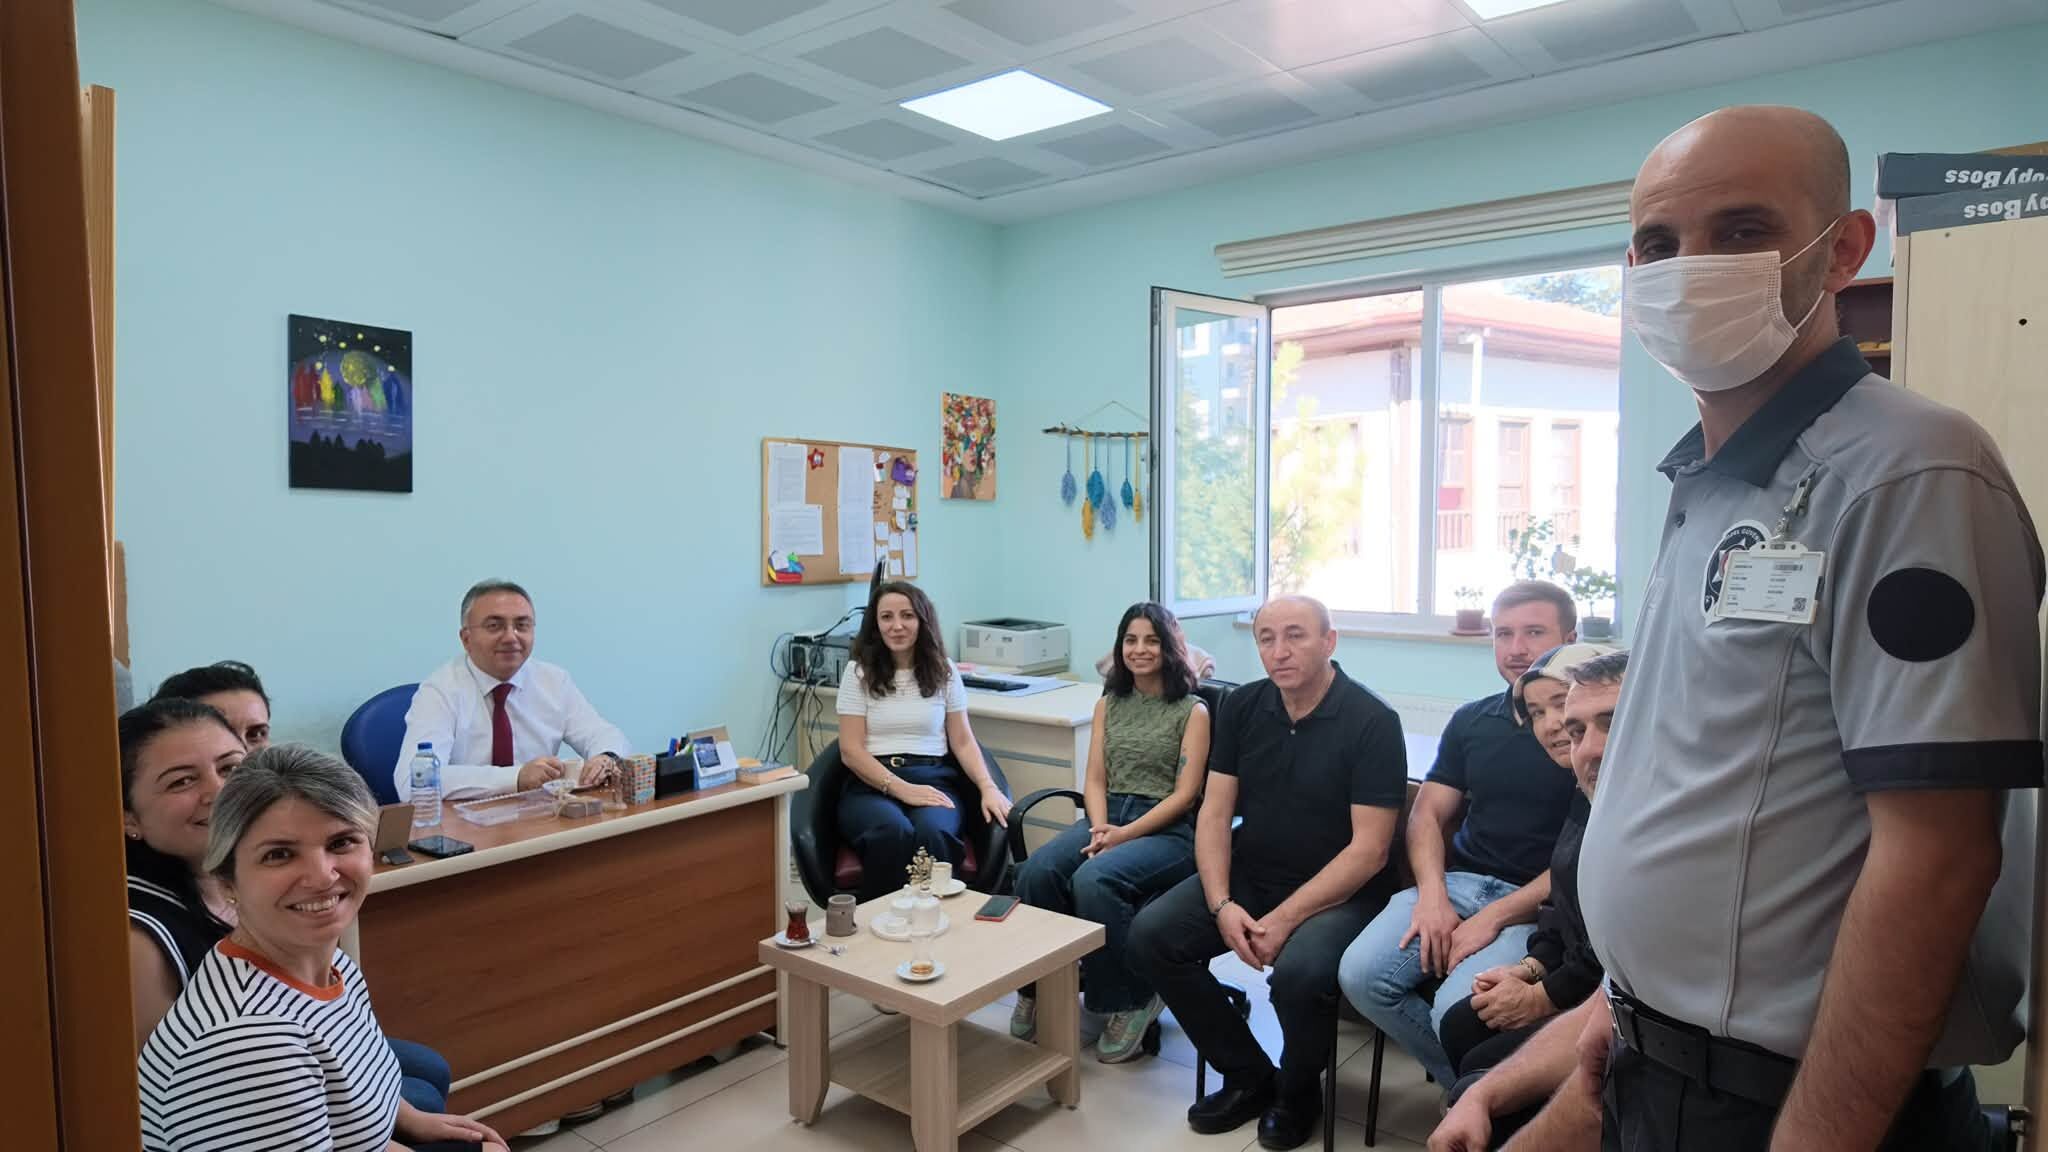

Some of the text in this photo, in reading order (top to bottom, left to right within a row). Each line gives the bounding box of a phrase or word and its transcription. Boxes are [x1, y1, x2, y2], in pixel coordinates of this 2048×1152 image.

[1944, 167, 2048, 189] opy Boss
[1963, 199, 2022, 220] Boss
